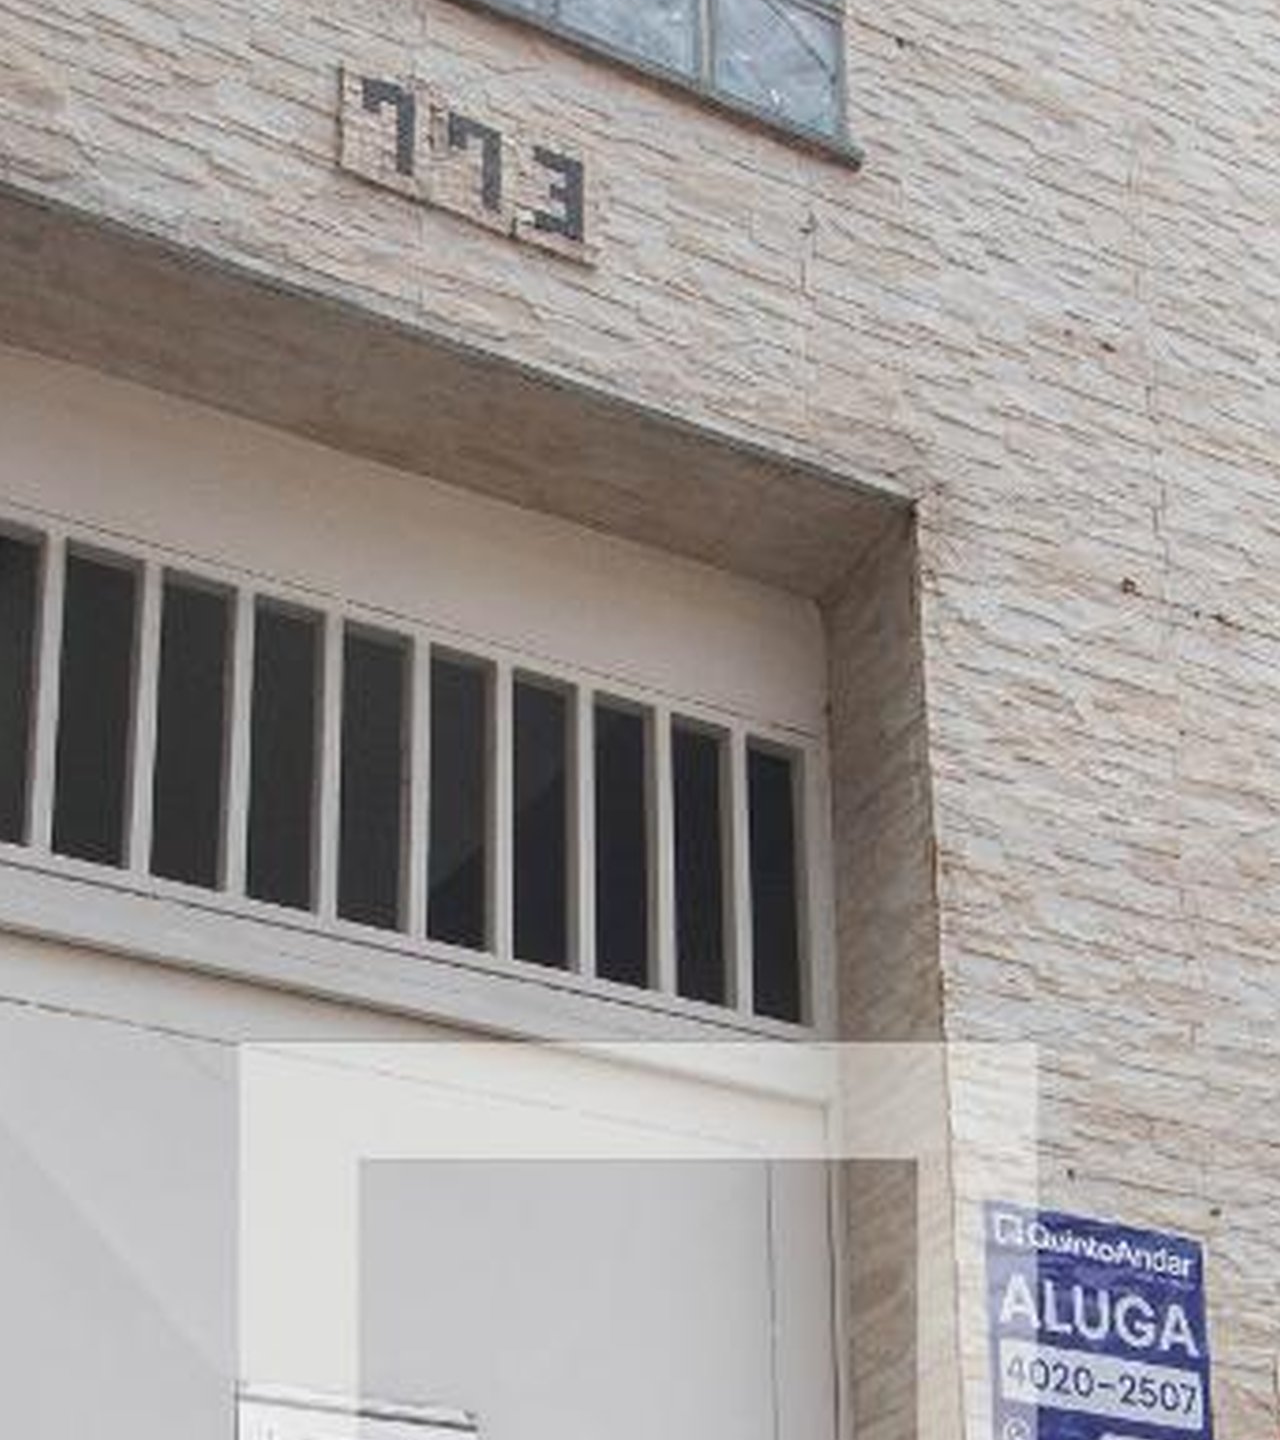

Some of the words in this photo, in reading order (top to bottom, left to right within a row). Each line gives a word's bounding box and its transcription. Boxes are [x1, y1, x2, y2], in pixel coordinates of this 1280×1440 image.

[361, 77, 585, 245] 773
[1027, 1221, 1194, 1278] QuintoAndar
[1000, 1273, 1201, 1359] ALUGA
[1007, 1354, 1198, 1416] 4020-2507
